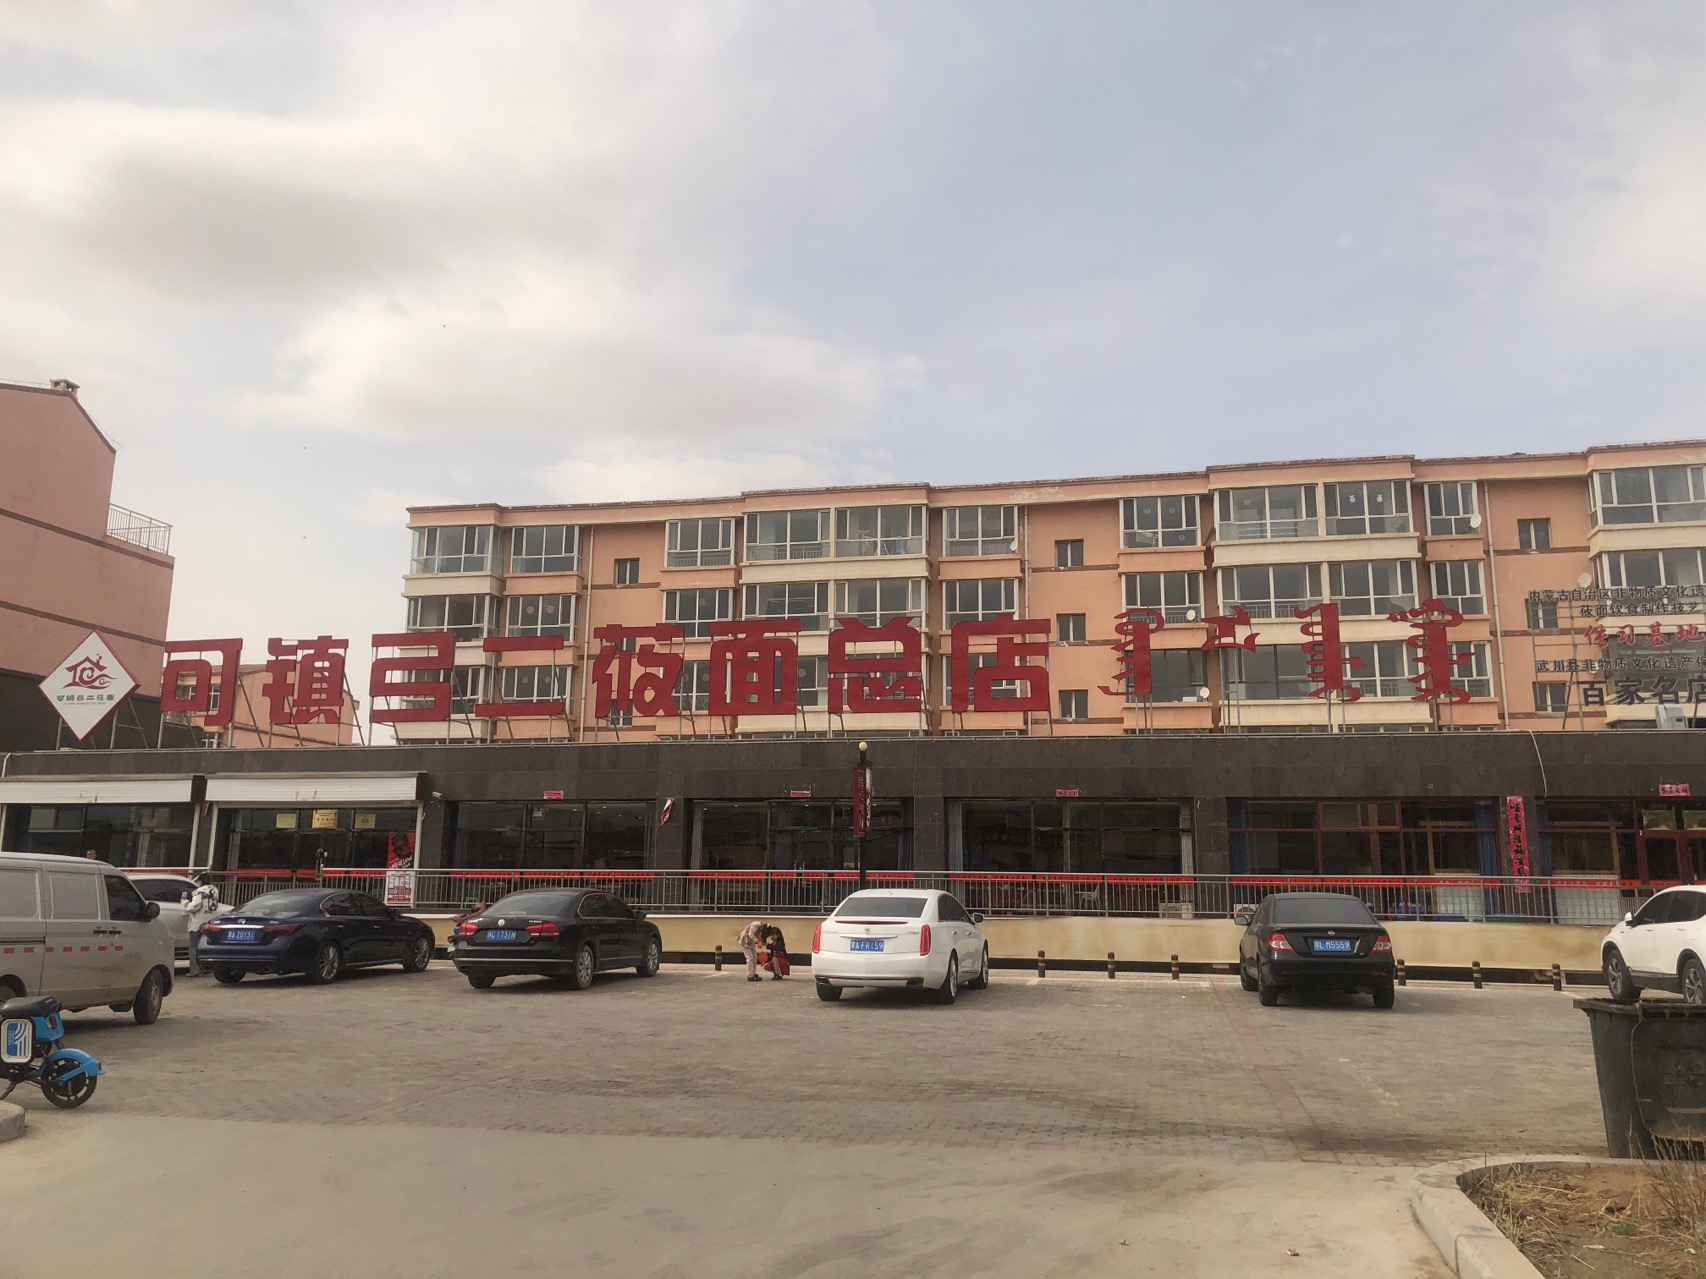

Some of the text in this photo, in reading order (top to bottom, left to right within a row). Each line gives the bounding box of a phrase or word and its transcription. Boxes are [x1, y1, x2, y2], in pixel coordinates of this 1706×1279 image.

[1580, 601, 1702, 617] 莜面饮食制作技艺
